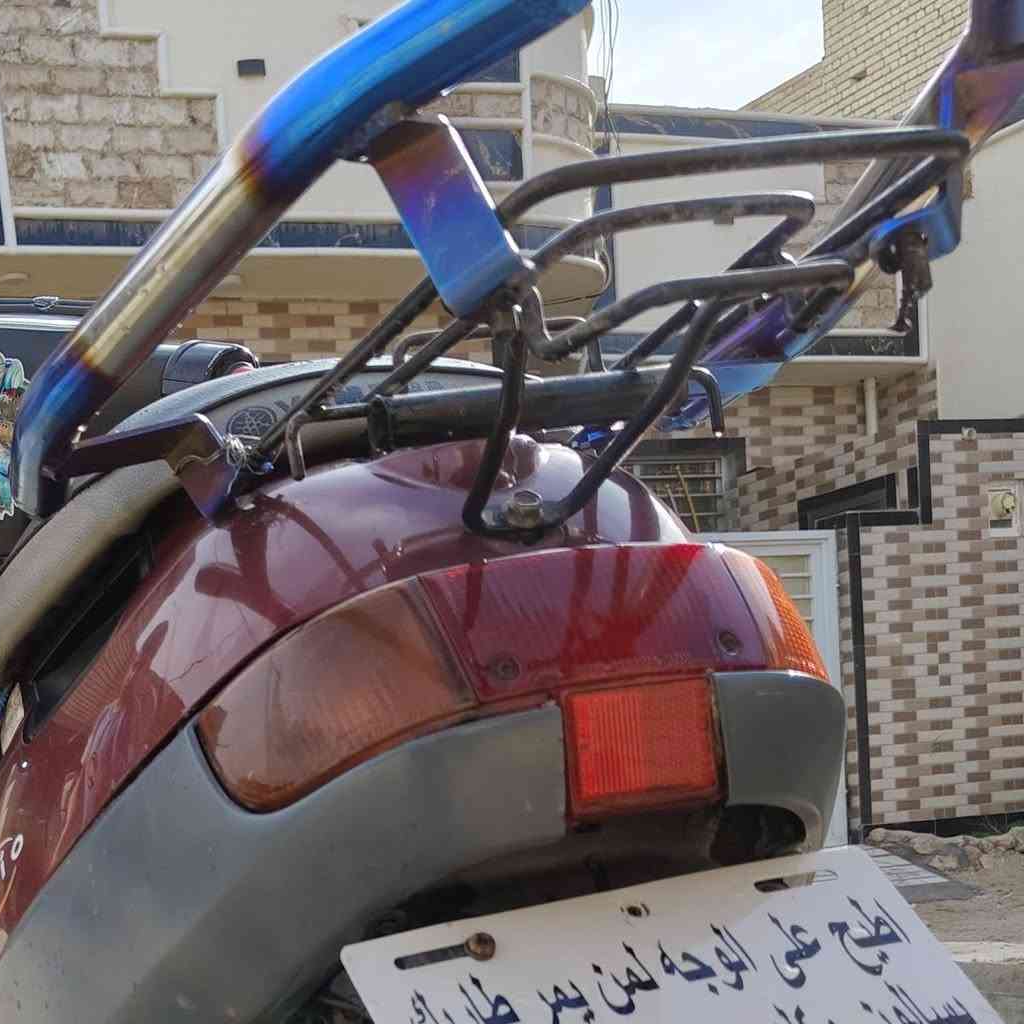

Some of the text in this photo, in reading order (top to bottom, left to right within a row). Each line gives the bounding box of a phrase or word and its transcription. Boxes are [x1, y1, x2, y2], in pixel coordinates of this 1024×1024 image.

[657, 924, 757, 996] الوجه
[828, 896, 911, 976] اطيح
[592, 941, 660, 1015] لمن
